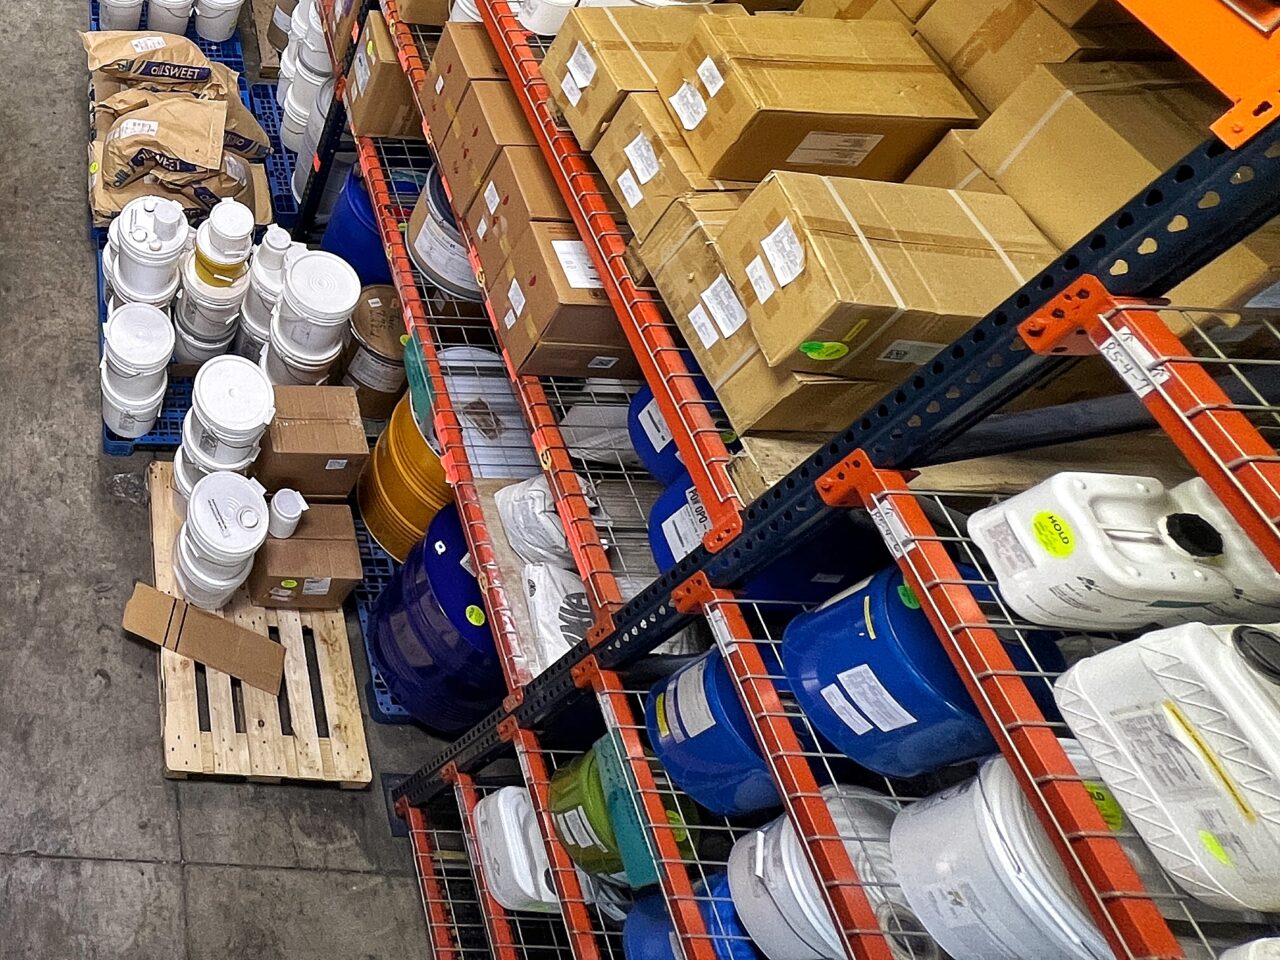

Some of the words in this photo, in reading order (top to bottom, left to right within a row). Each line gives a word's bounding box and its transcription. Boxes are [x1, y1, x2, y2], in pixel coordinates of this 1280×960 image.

[150, 64, 201, 80] allSWEET
[1100, 340, 1152, 391] R5-4-7
[1047, 515, 1070, 545] HOLD
